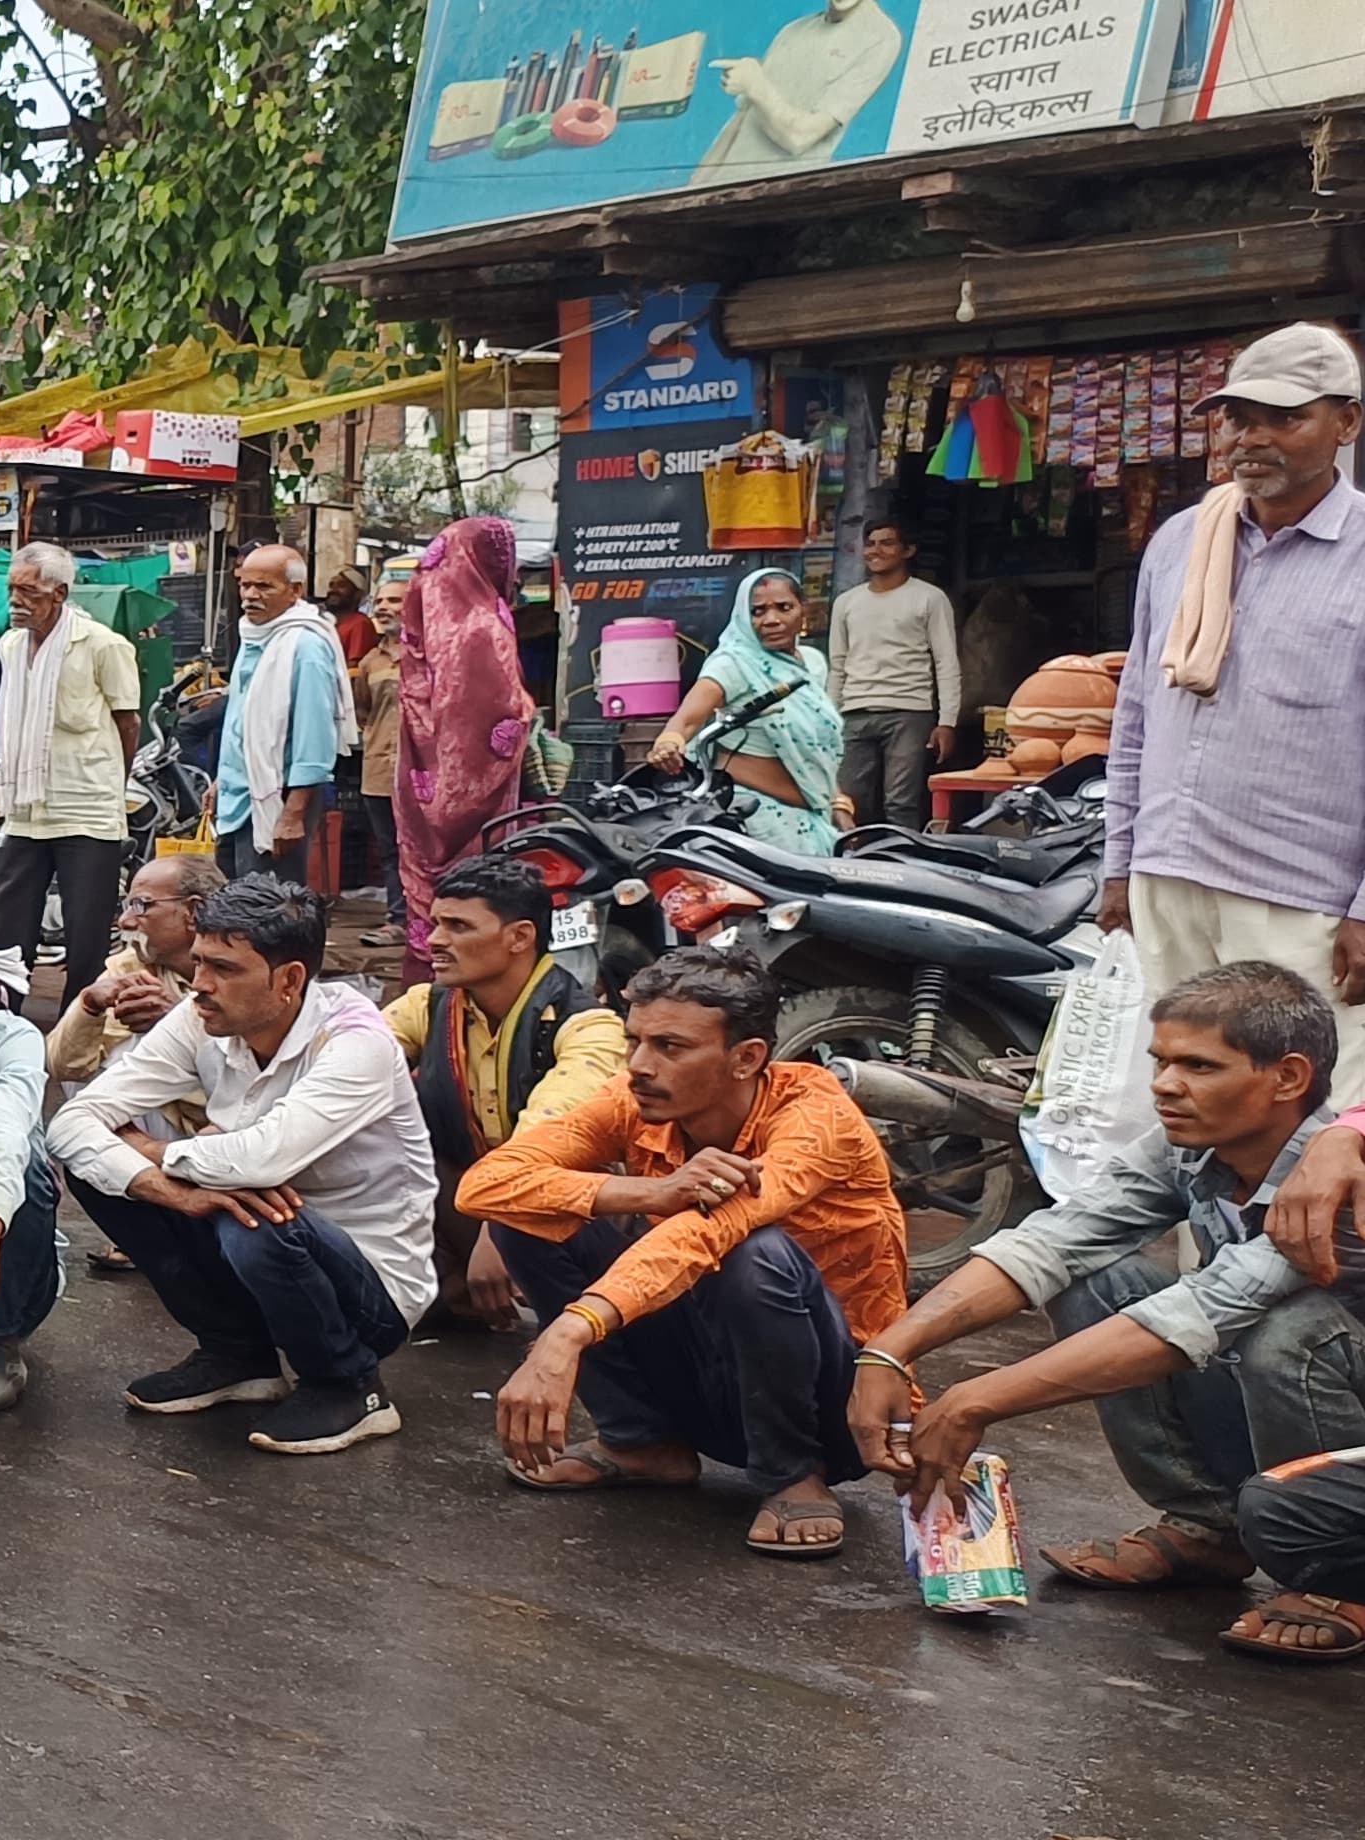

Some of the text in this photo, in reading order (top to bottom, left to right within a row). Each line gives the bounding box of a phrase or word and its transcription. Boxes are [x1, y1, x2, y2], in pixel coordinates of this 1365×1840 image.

[928, 16, 1116, 68] ELECTRICALS
[969, 61, 1060, 95] स्वागत
[603, 380, 739, 412] STANDARD
[576, 455, 635, 481] HOME
[664, 450, 716, 475] SHIE
[609, 521, 681, 537] INSULATION
[584, 541, 626, 555] SAFETY
[626, 540, 642, 553] AT
[584, 553, 734, 572] EXTRA CURRENT CAPACITY
[572, 581, 600, 600] GO
[602, 579, 646, 599] FOR
[1049, 975, 1098, 1125] GENETIC EXPRE
